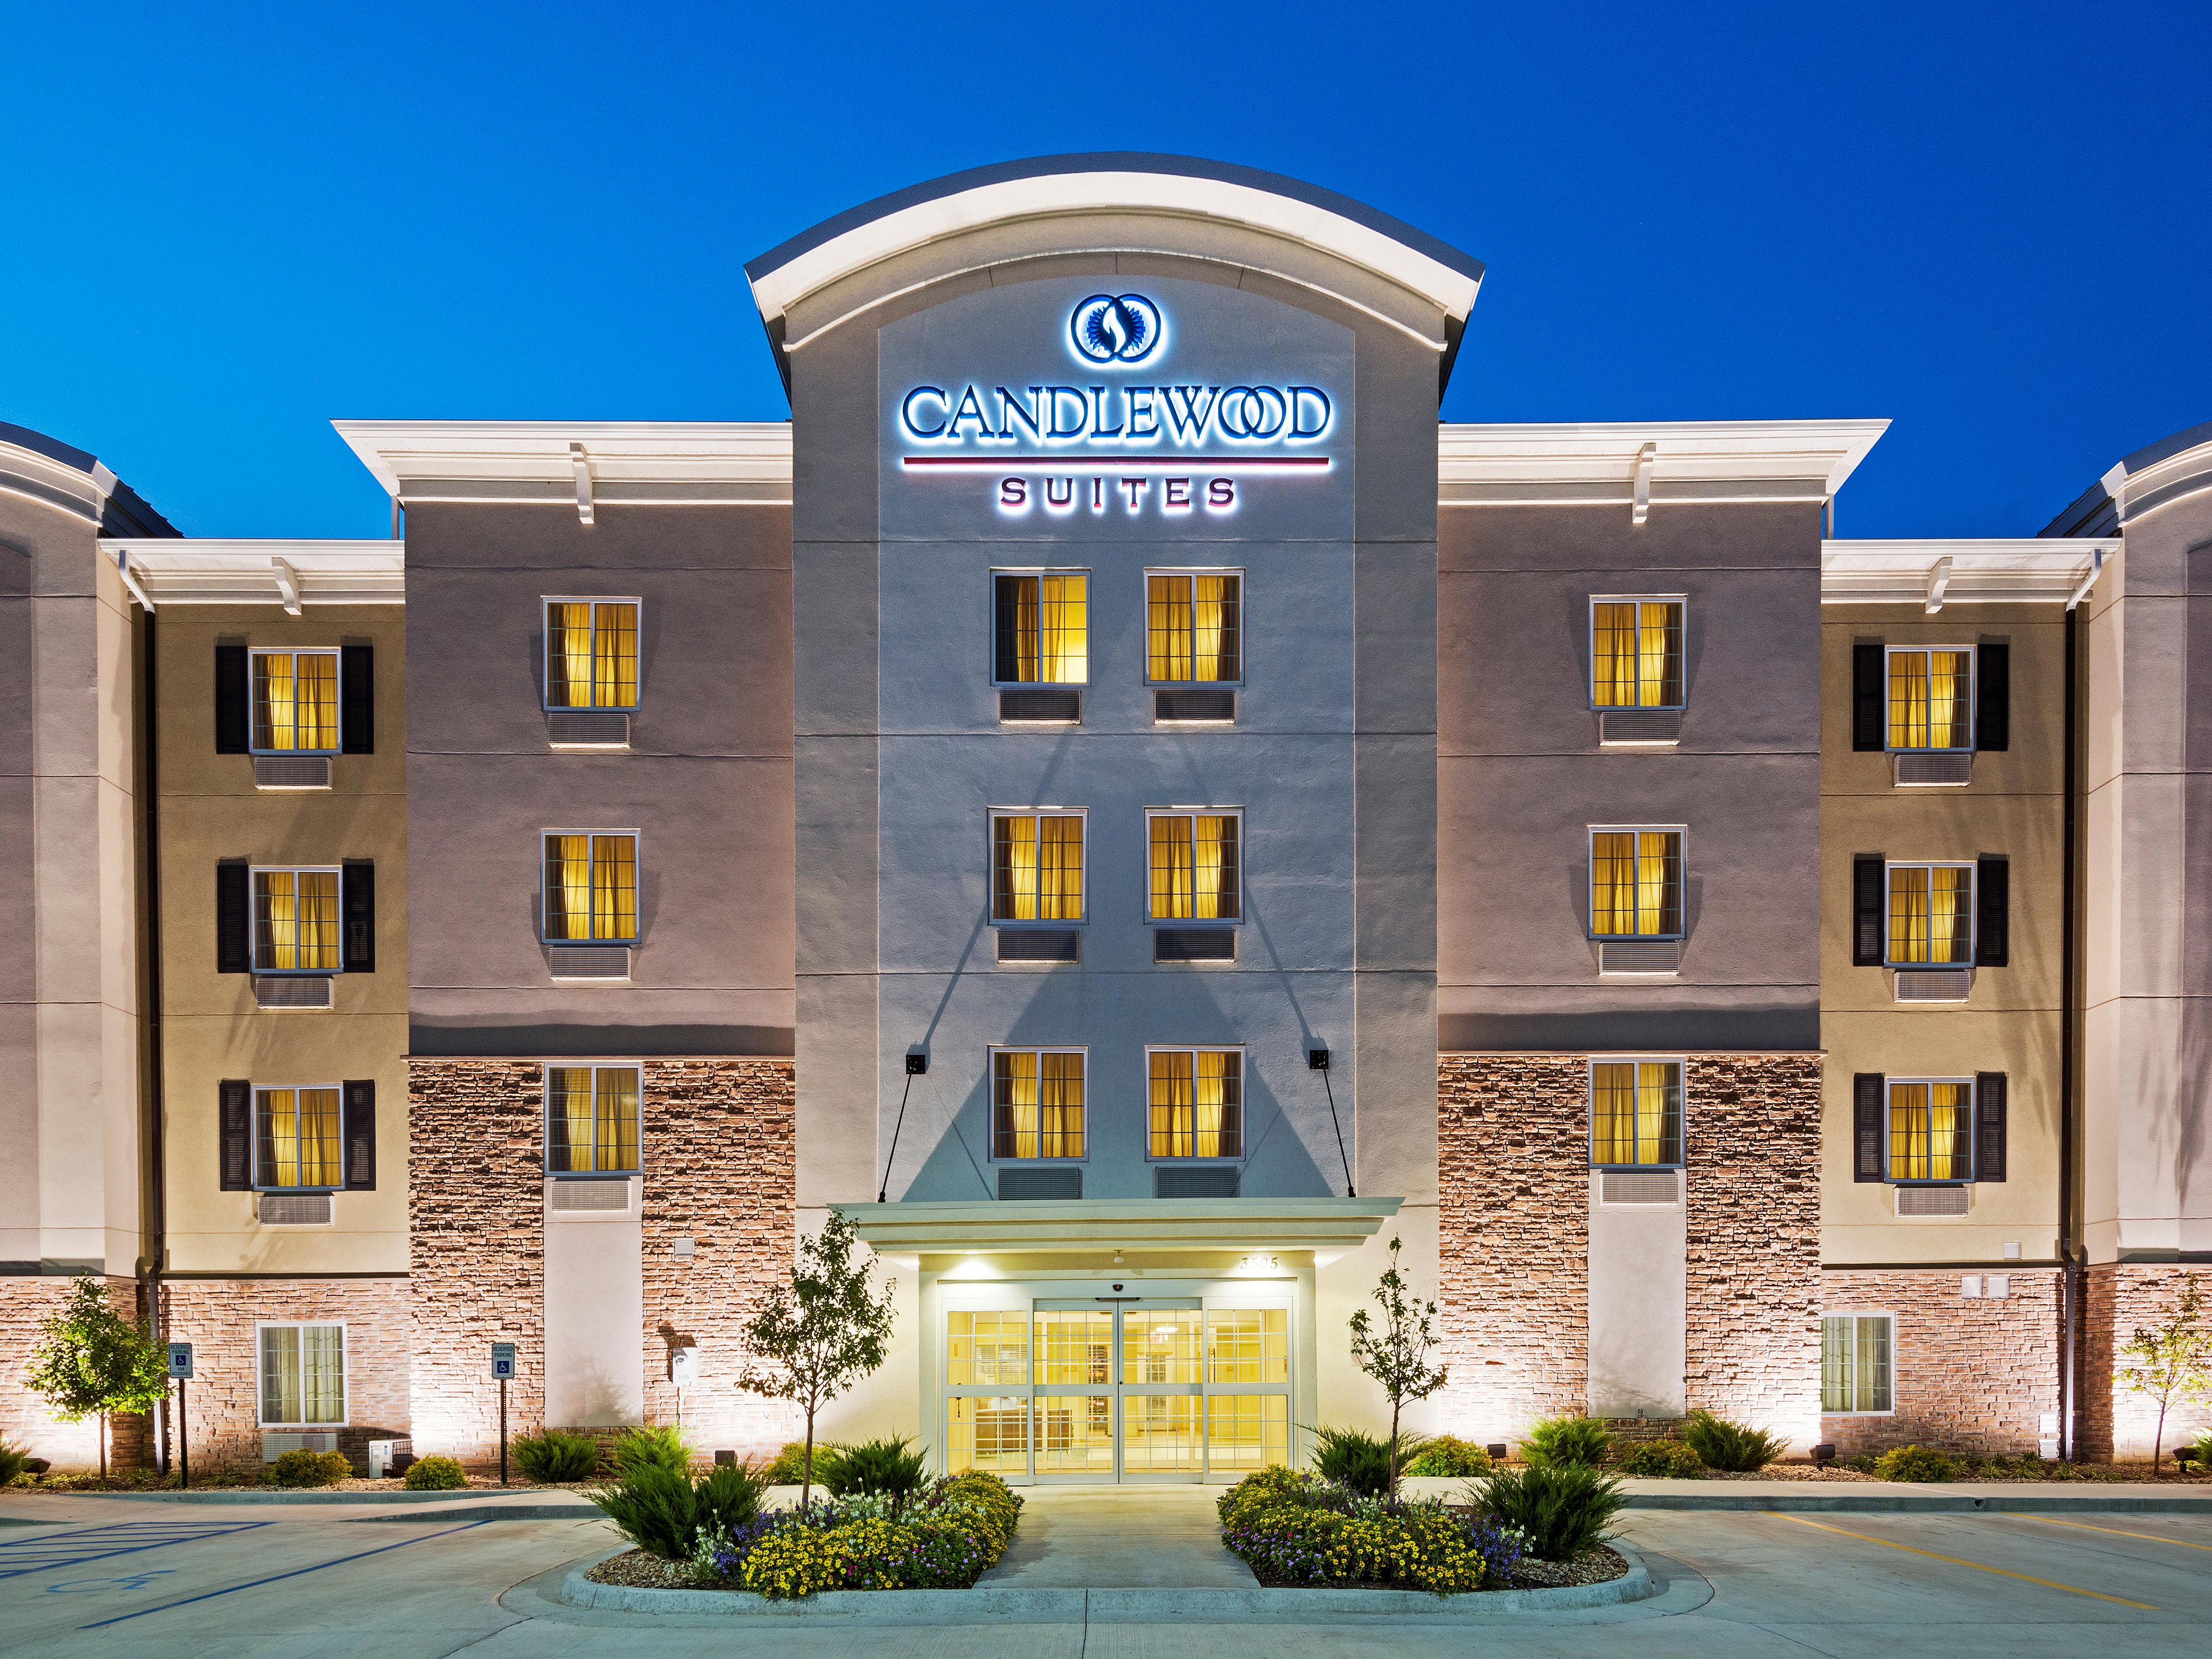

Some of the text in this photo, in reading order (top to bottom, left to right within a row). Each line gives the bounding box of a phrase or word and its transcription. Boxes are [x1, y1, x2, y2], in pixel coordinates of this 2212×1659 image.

[902, 385, 1331, 440] CANDLEWOOD
[1000, 478, 1235, 508] SUITES
[1240, 1257, 1278, 1270] 3505
